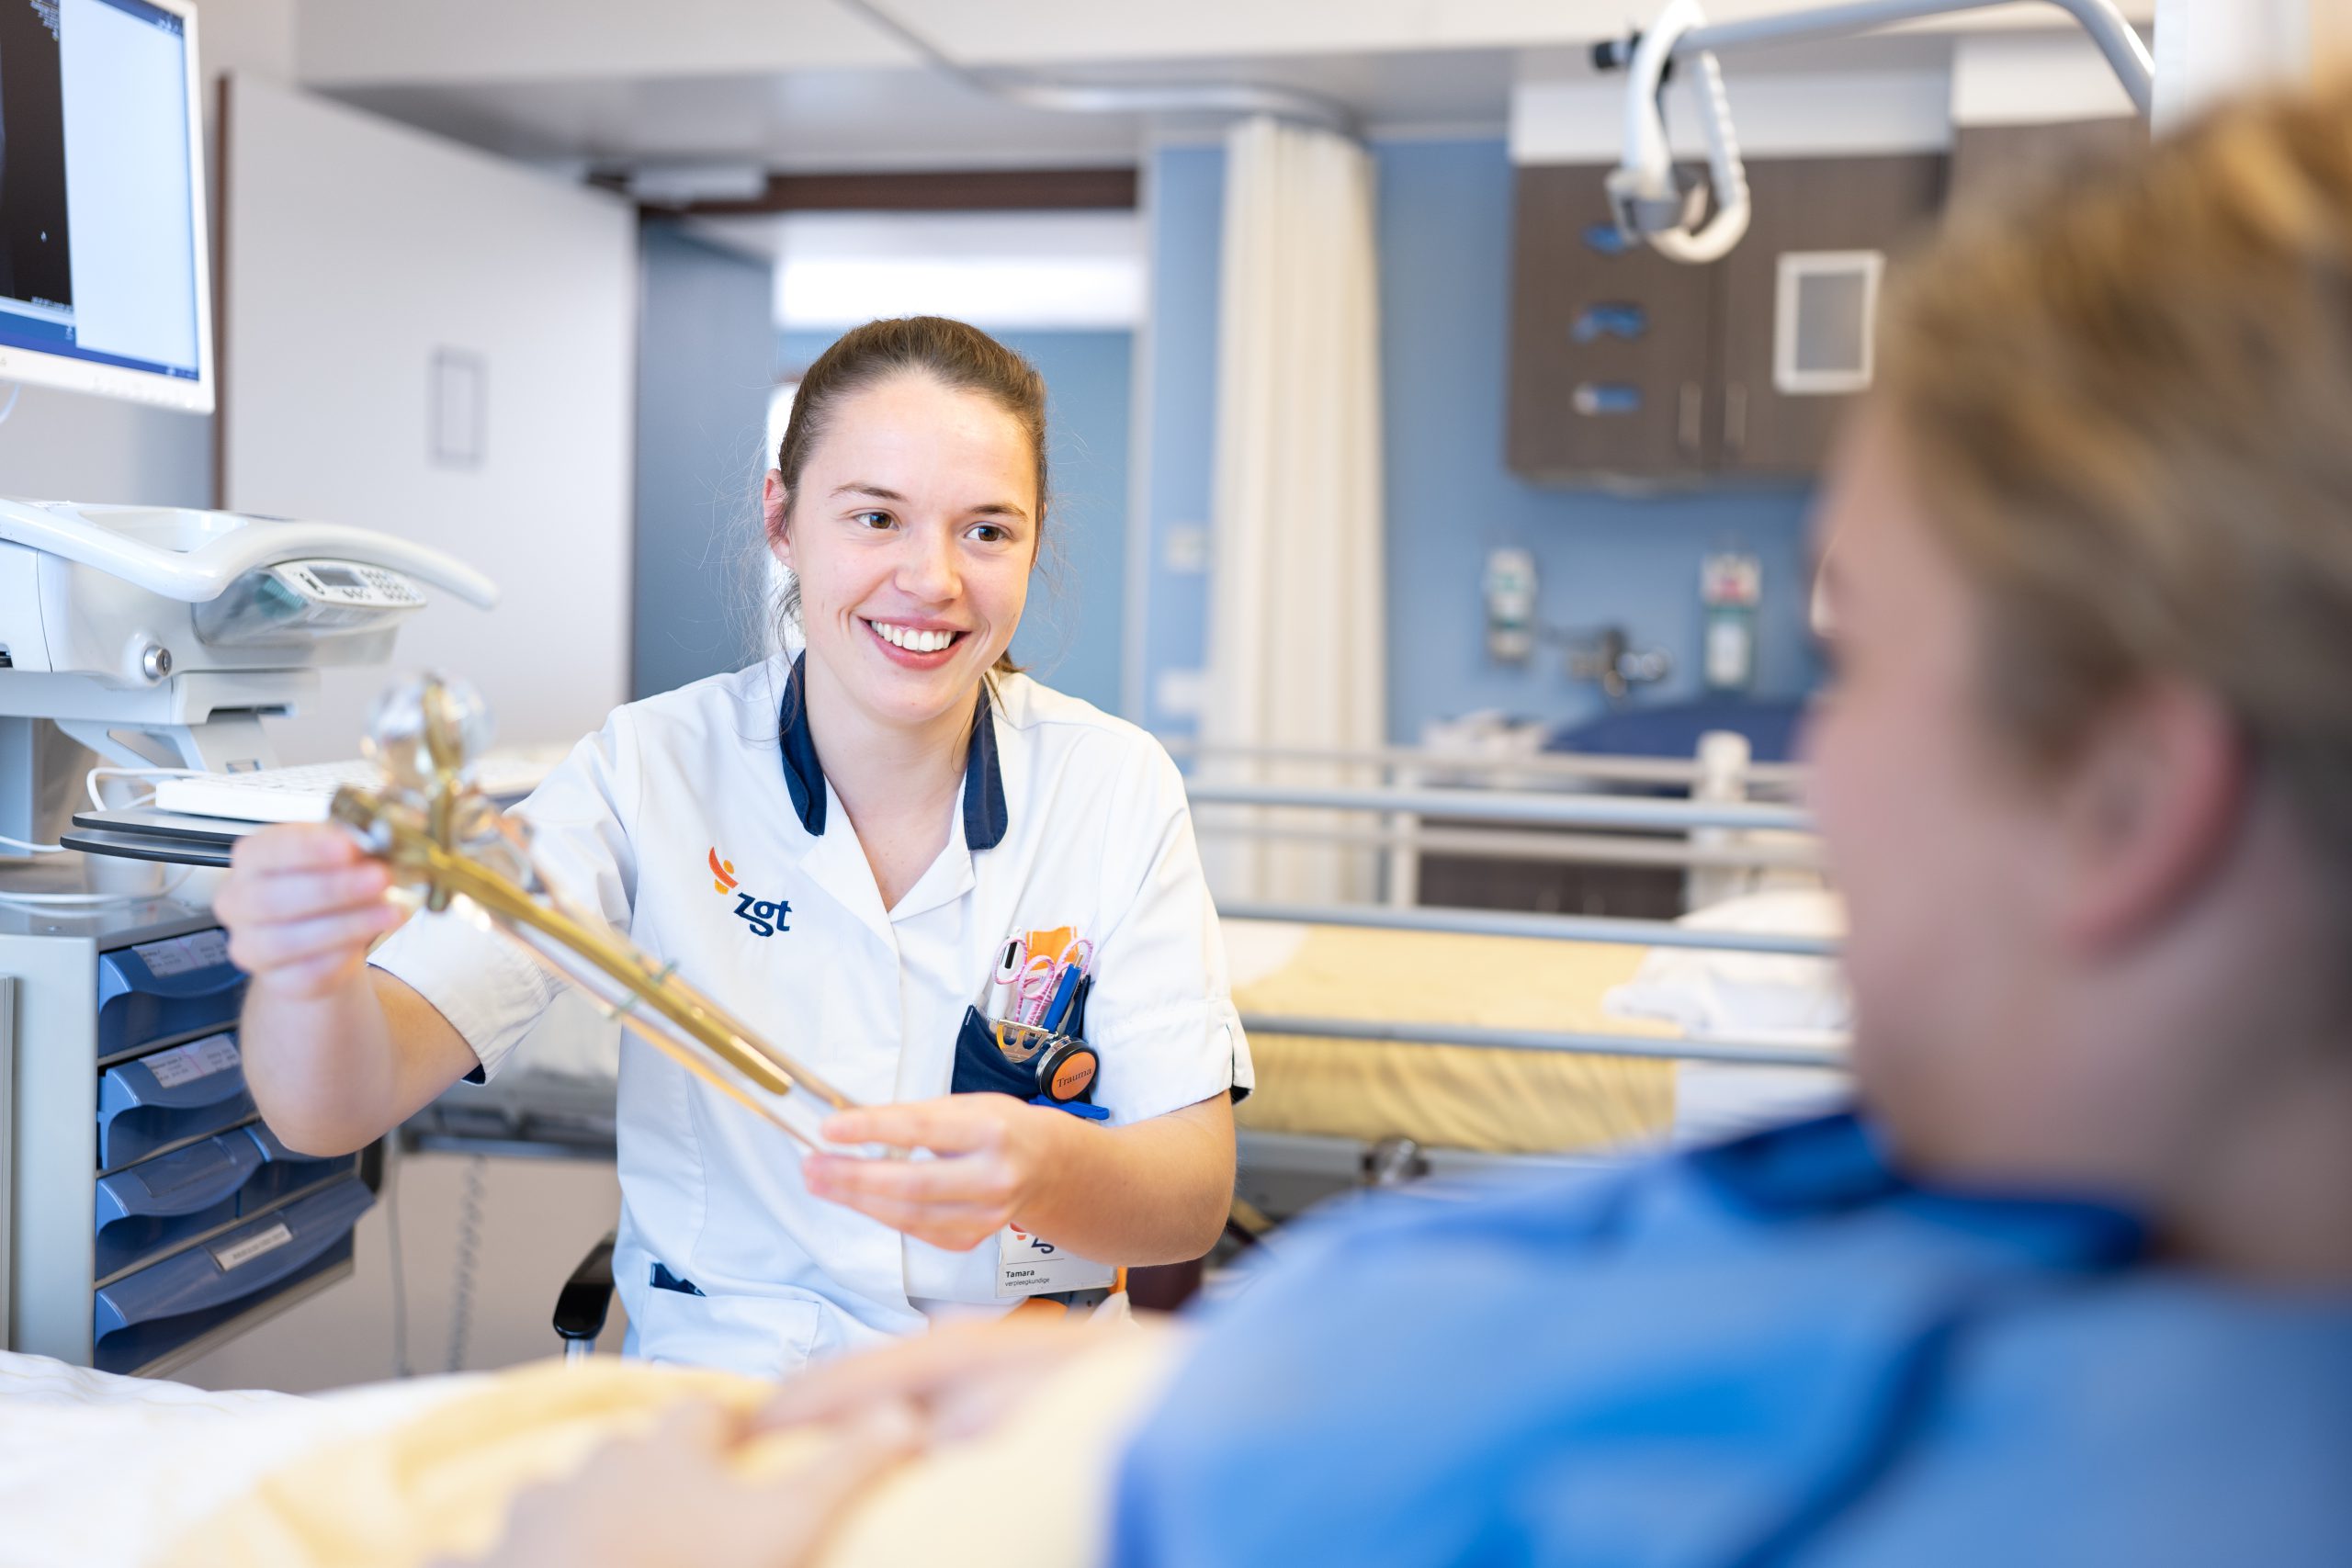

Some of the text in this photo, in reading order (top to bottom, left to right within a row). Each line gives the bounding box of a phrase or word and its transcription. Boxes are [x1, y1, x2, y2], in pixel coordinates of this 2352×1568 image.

[733, 892, 793, 938] zgt
[1057, 1068, 1091, 1088] Trauma
[1005, 1269, 1035, 1278] Tamara
